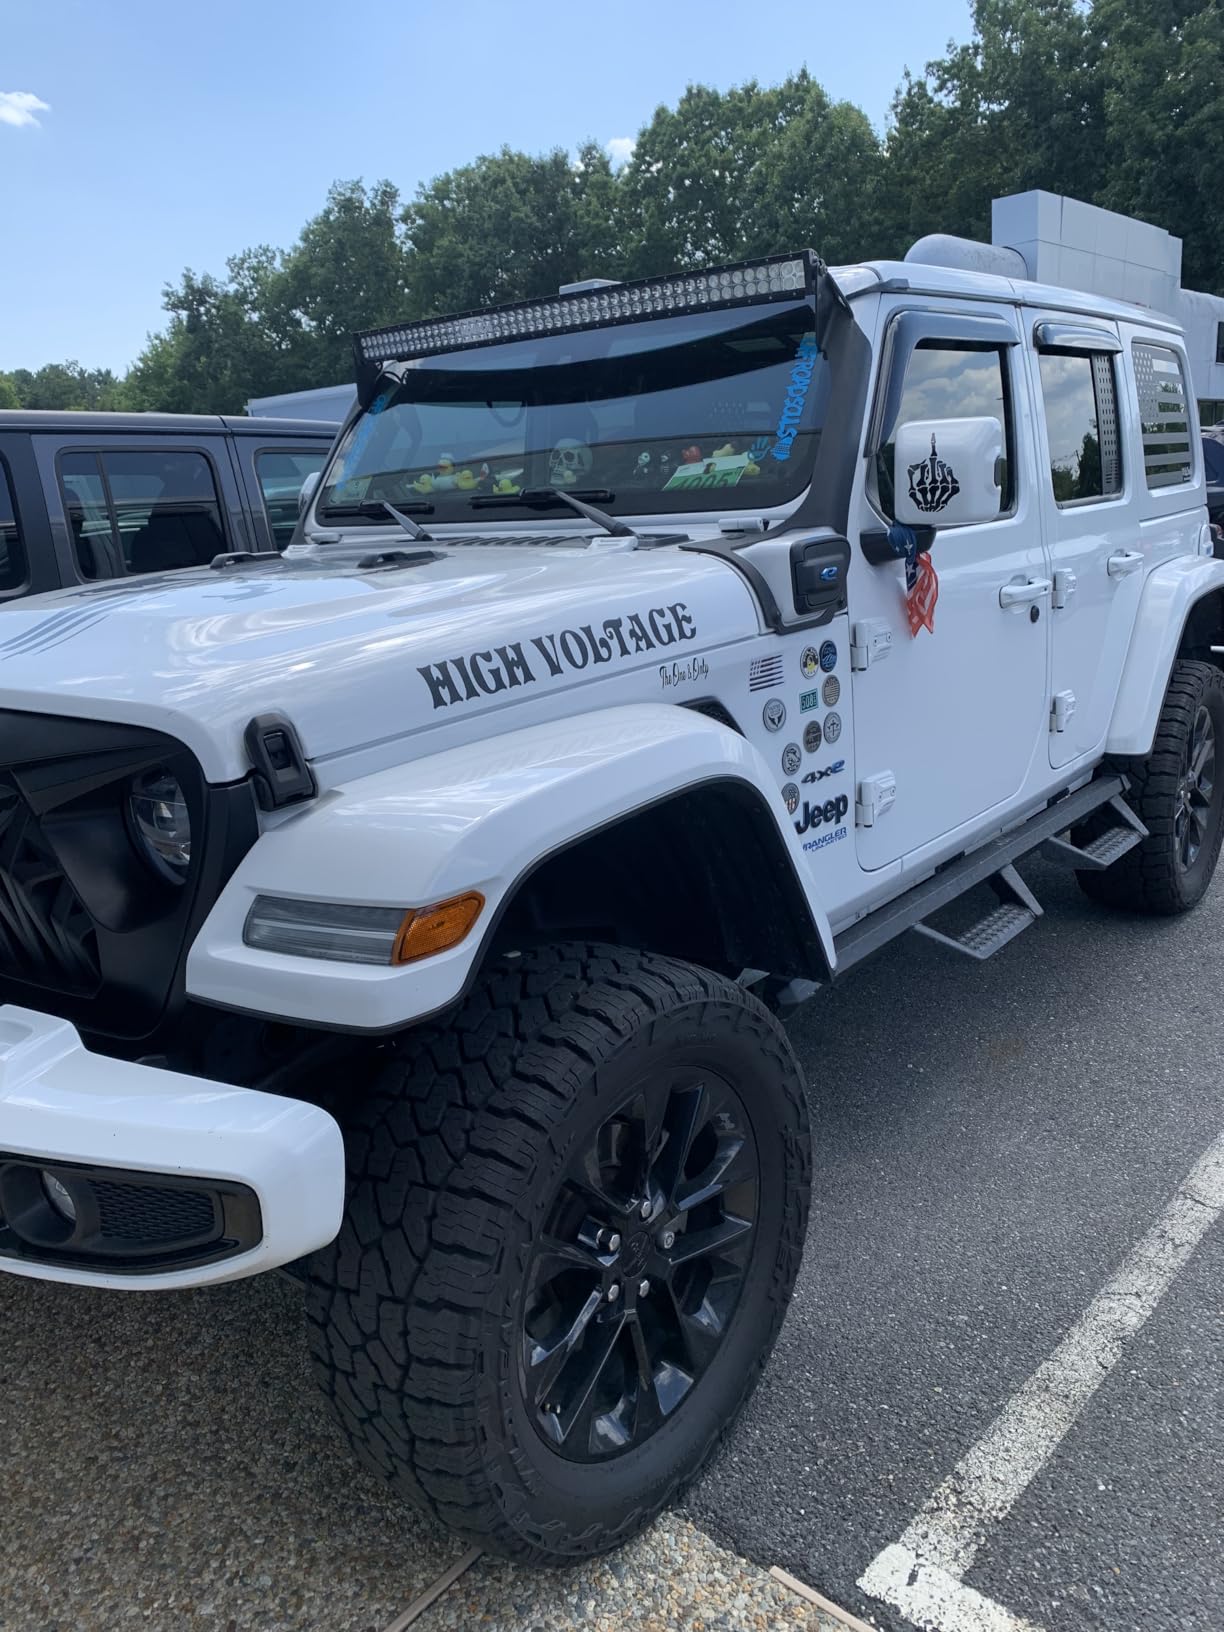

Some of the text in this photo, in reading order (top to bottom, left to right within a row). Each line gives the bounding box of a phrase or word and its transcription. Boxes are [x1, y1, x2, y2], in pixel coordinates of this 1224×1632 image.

[416, 602, 697, 710] HIGH VOLTAGE
[659, 665, 672, 689] The
[672, 662, 686, 687] One
[692, 657, 709, 680] Only
[801, 760, 846, 784] 4xe
[794, 794, 849, 835] Jeep
